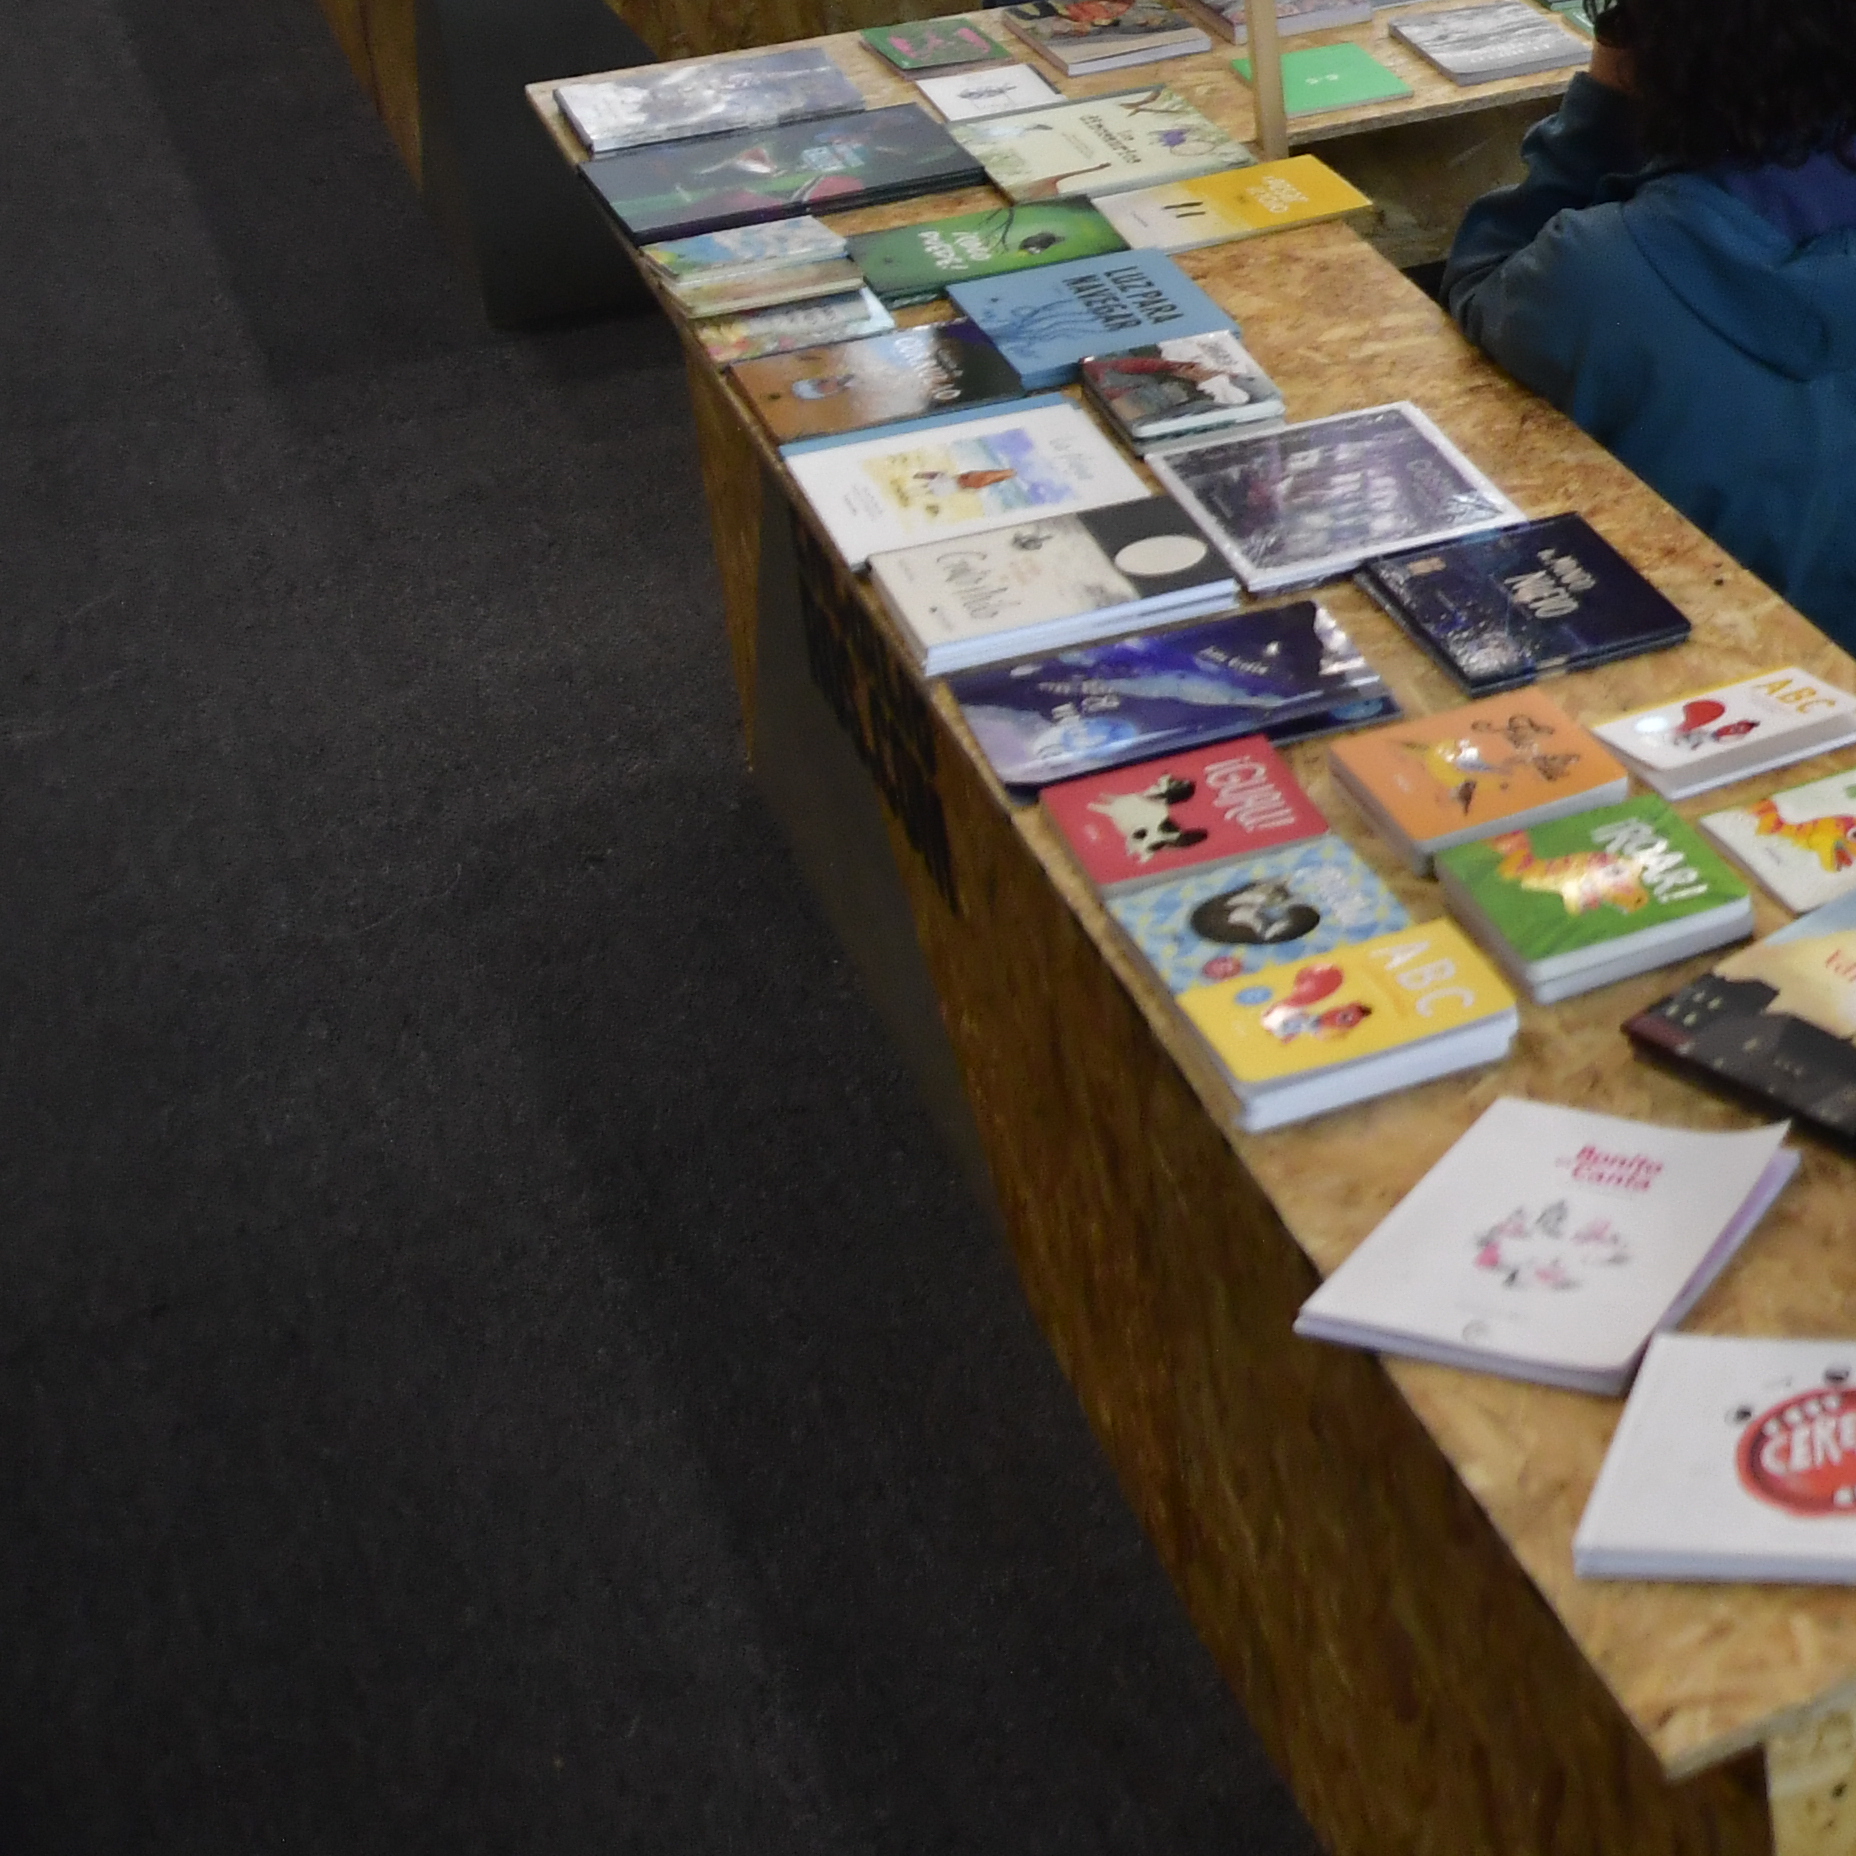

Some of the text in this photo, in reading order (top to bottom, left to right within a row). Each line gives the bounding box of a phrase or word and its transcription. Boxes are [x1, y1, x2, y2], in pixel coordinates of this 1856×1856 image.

[1061, 273, 1143, 333] NAVEGAR
[1103, 265, 1185, 325] LUZ PARA
[1752, 678, 1836, 714] ABC
[1368, 939, 1477, 1019] ABC
